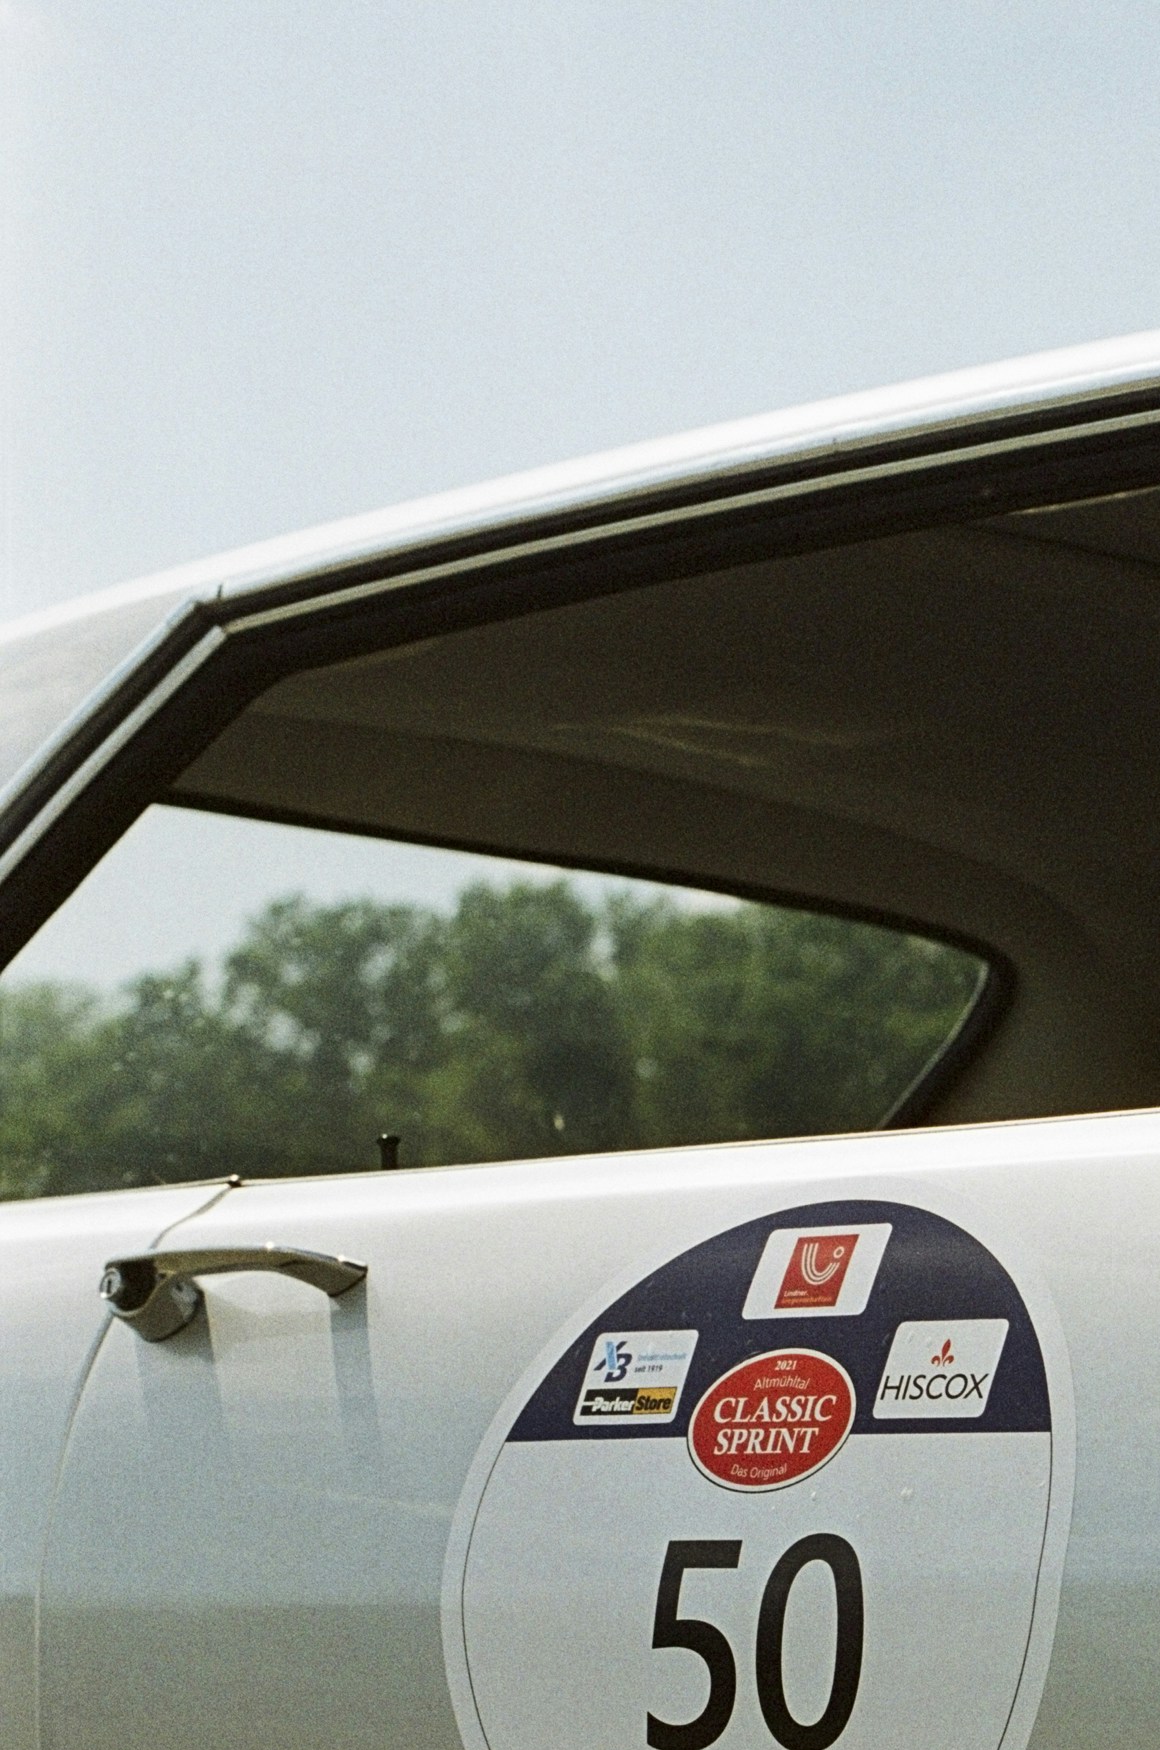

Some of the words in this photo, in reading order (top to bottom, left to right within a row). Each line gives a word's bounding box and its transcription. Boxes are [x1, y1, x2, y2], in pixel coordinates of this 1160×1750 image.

[774, 1359, 797, 1371] 2021
[753, 1374, 811, 1391] Altmühltal
[880, 1373, 990, 1400] HISCOX
[713, 1394, 837, 1424] CLASSIC
[713, 1427, 819, 1456] SPRINT
[730, 1463, 748, 1478] Das
[749, 1463, 787, 1480] Original
